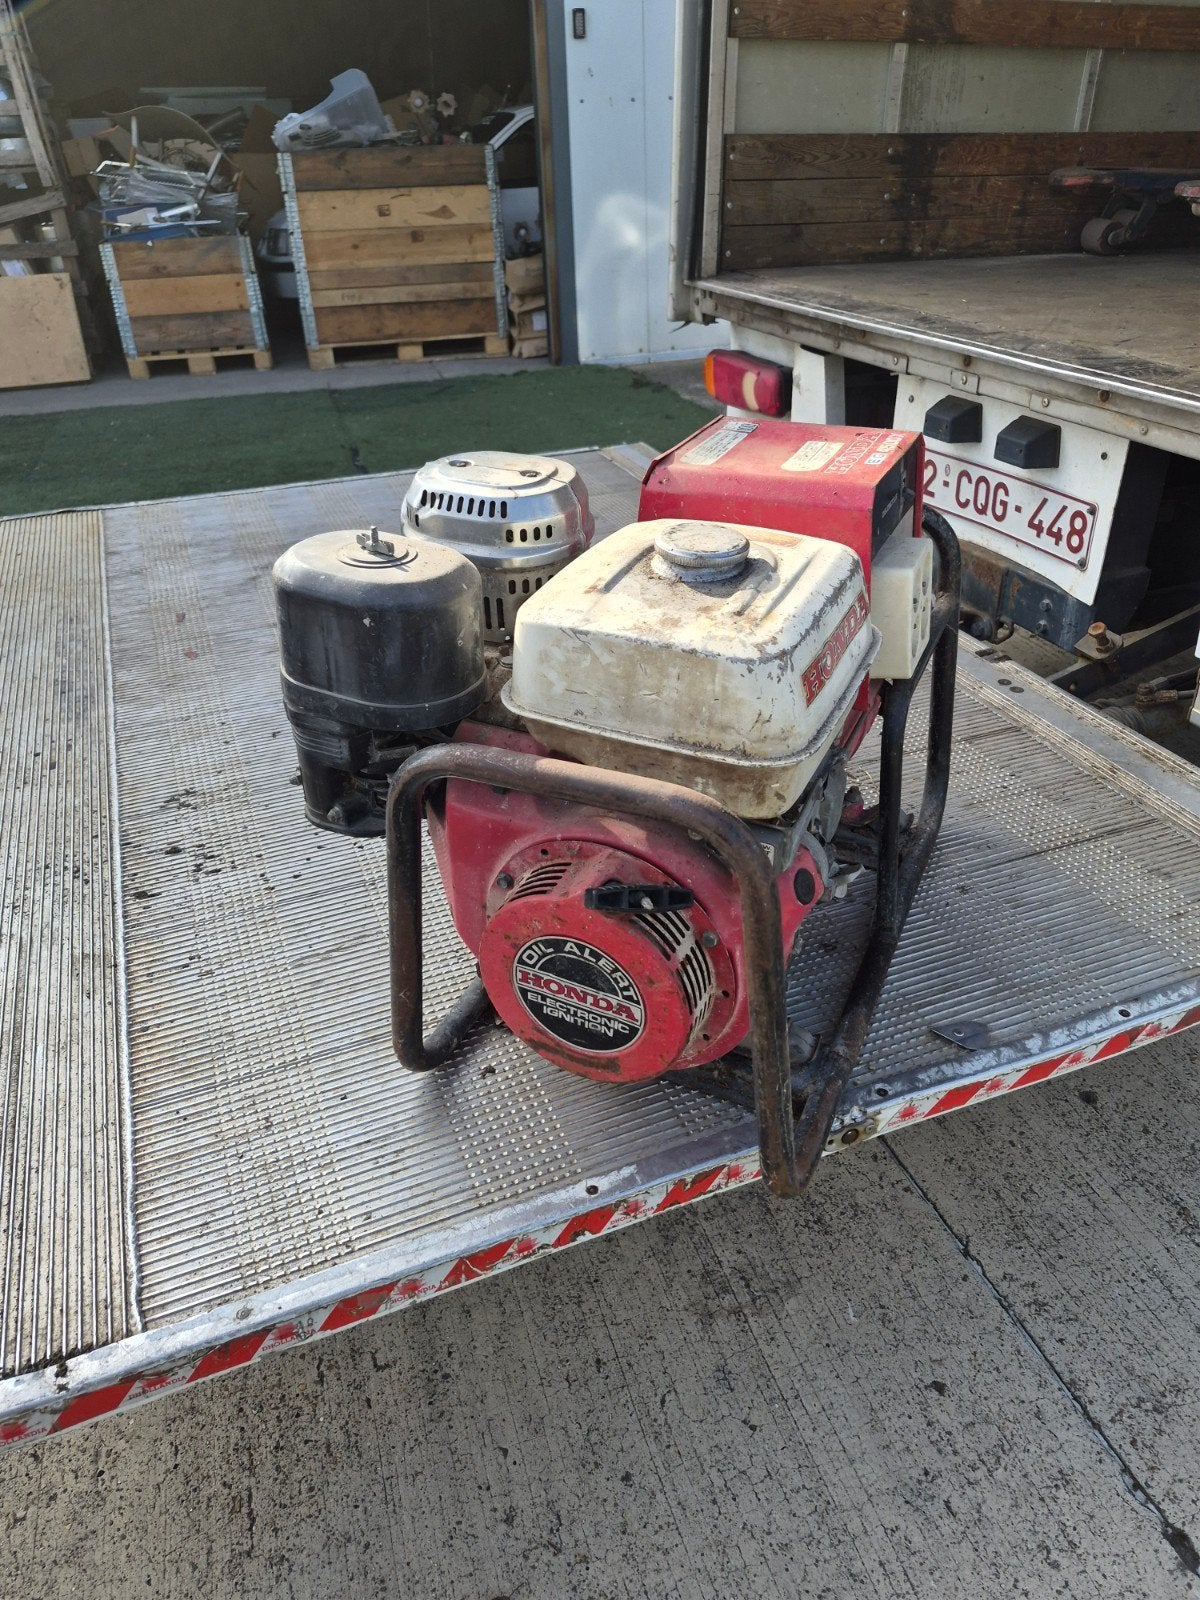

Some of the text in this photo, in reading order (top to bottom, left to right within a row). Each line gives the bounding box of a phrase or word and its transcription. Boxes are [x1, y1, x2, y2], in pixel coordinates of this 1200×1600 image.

[802, 592, 870, 708] HONDA
[518, 970, 638, 1021] HONDA
[522, 942, 638, 1002] OIL ALERT
[527, 992, 629, 1034] ELECTRONIC
[543, 1005, 614, 1037] IGNITION
